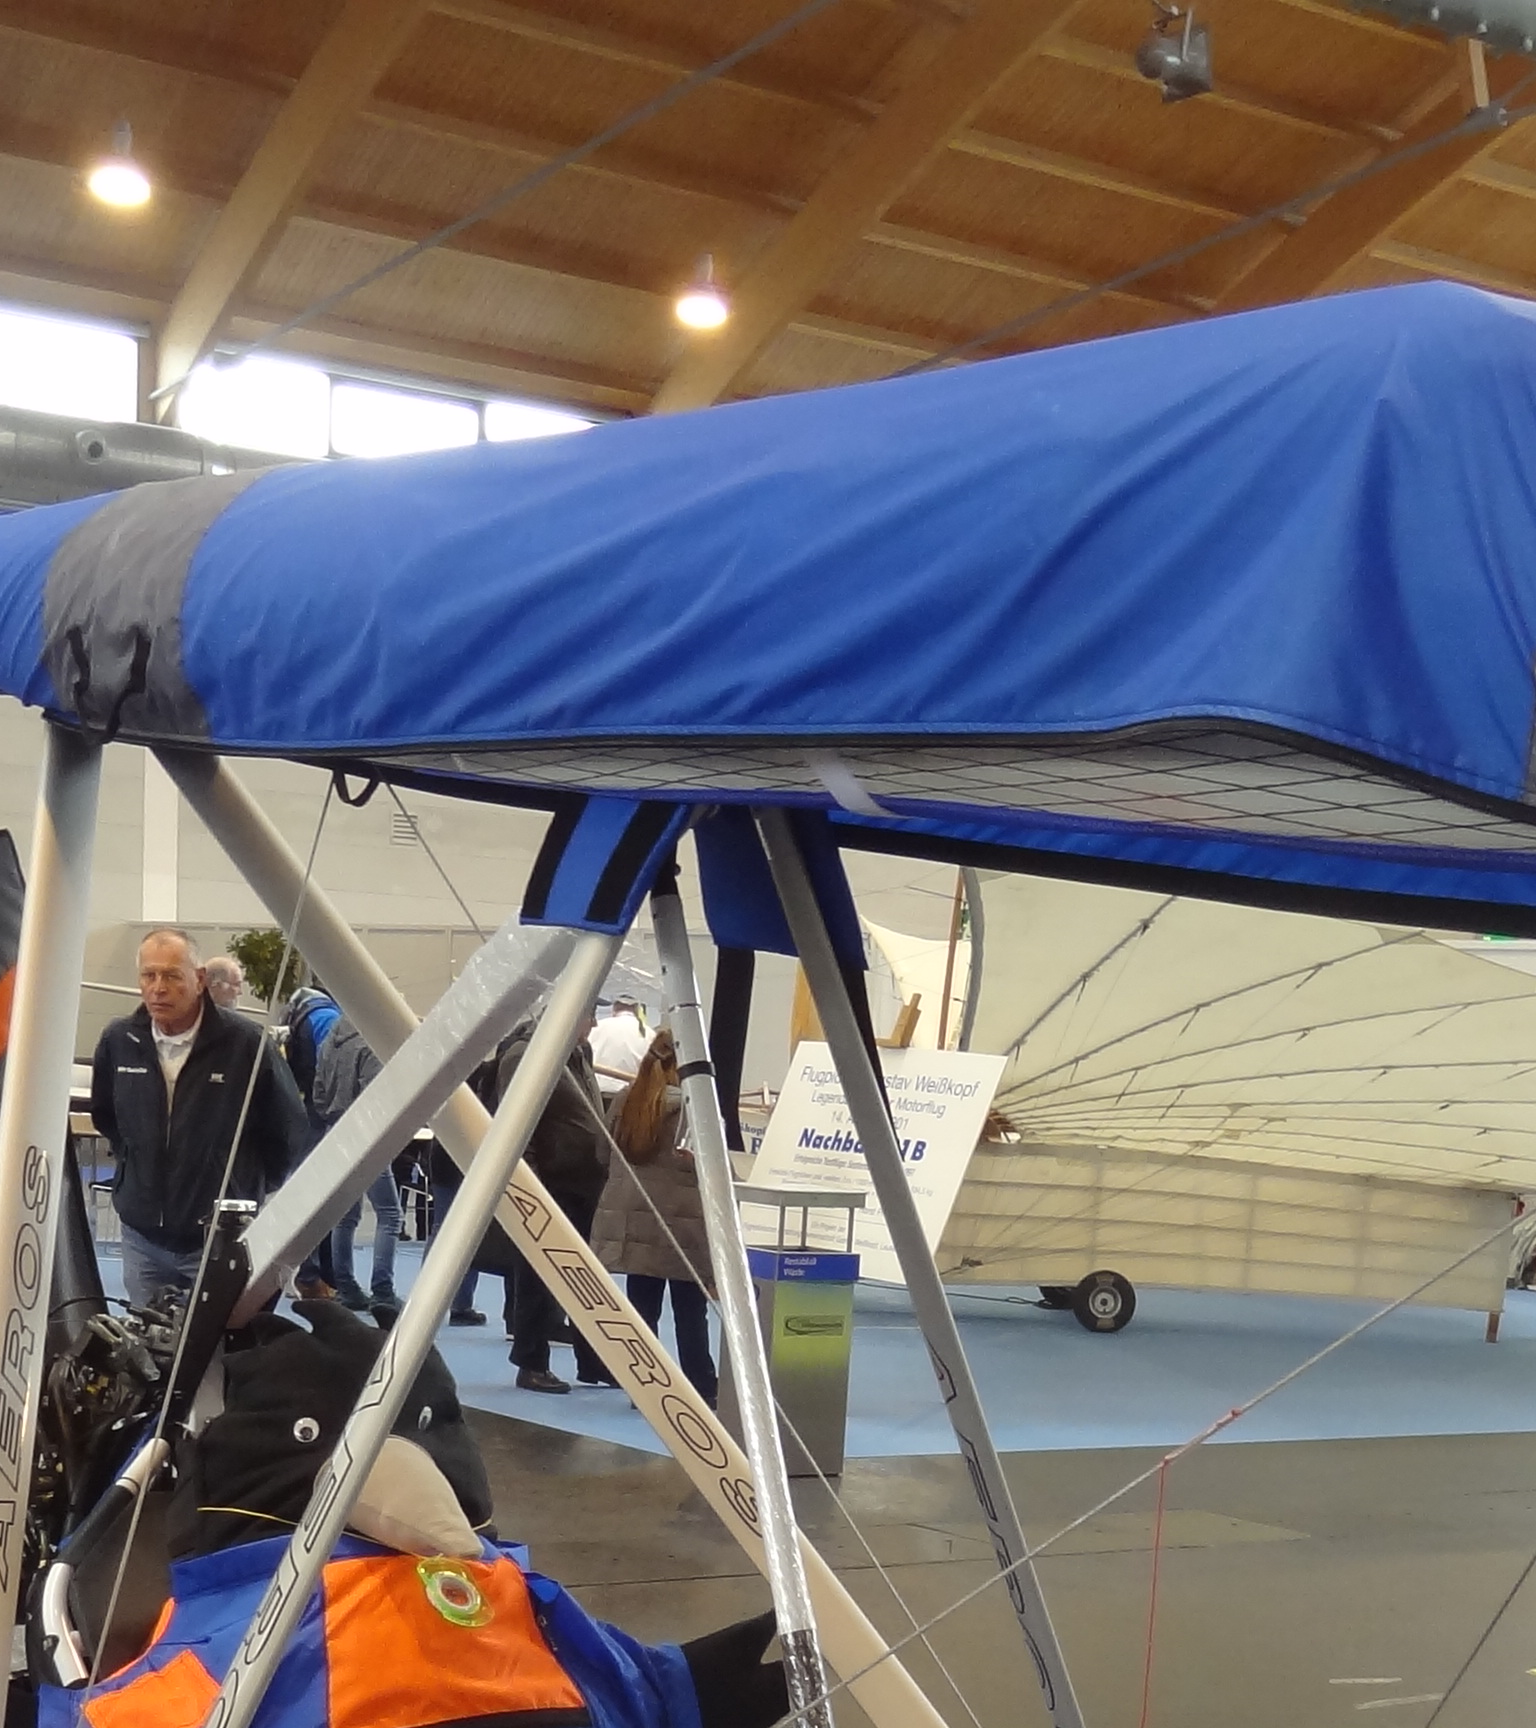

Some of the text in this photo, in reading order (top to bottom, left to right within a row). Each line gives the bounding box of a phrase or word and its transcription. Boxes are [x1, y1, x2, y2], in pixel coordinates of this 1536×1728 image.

[914, 1075, 982, 1101] Weißkopf
[895, 1097, 946, 1119] Motorflug
[797, 1128, 865, 1154] Nachba
[505, 1181, 763, 1541] AEROS
